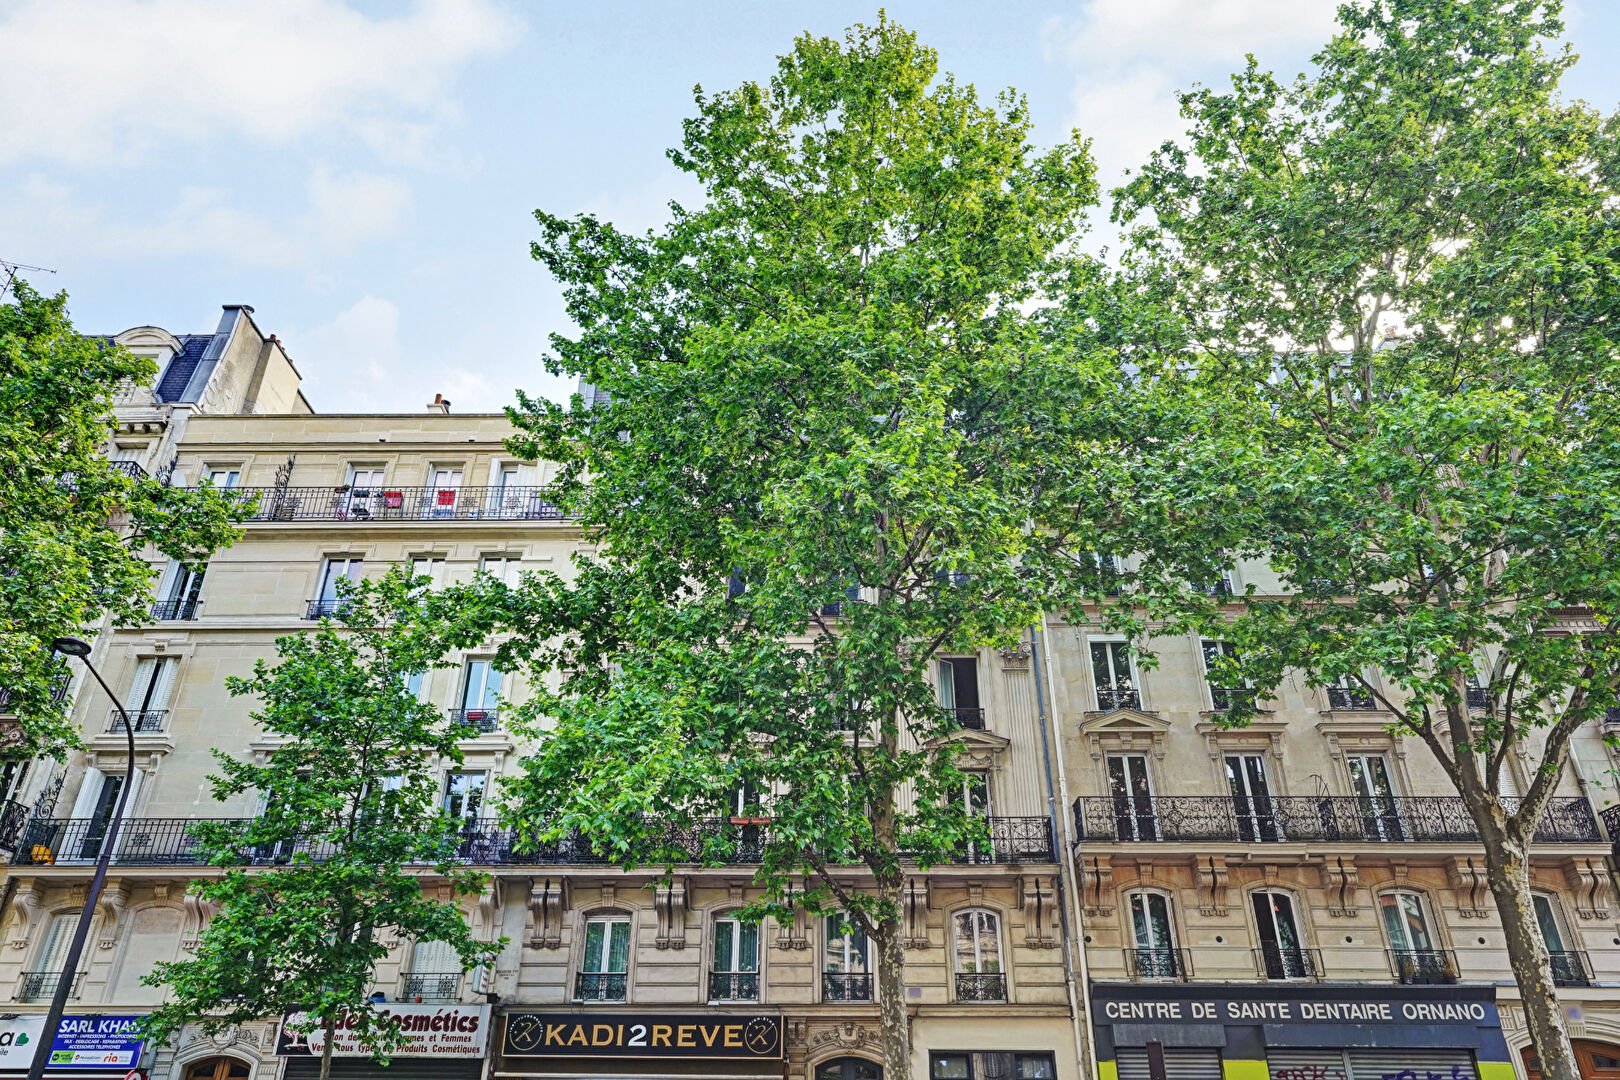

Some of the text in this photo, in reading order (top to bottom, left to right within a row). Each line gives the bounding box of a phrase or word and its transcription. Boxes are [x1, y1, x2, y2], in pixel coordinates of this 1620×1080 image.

[1105, 1002, 1486, 1020] CENTRE DE SANTE DENTAIRE ORNANO
[58, 1020, 95, 1033] SARL
[429, 1034, 436, 1042] et
[441, 1034, 472, 1043] Femmes
[358, 1044, 376, 1053] type
[396, 1044, 428, 1053] Produits
[432, 1044, 480, 1055] Cosmétiques
[103, 1053, 118, 1063] ria
